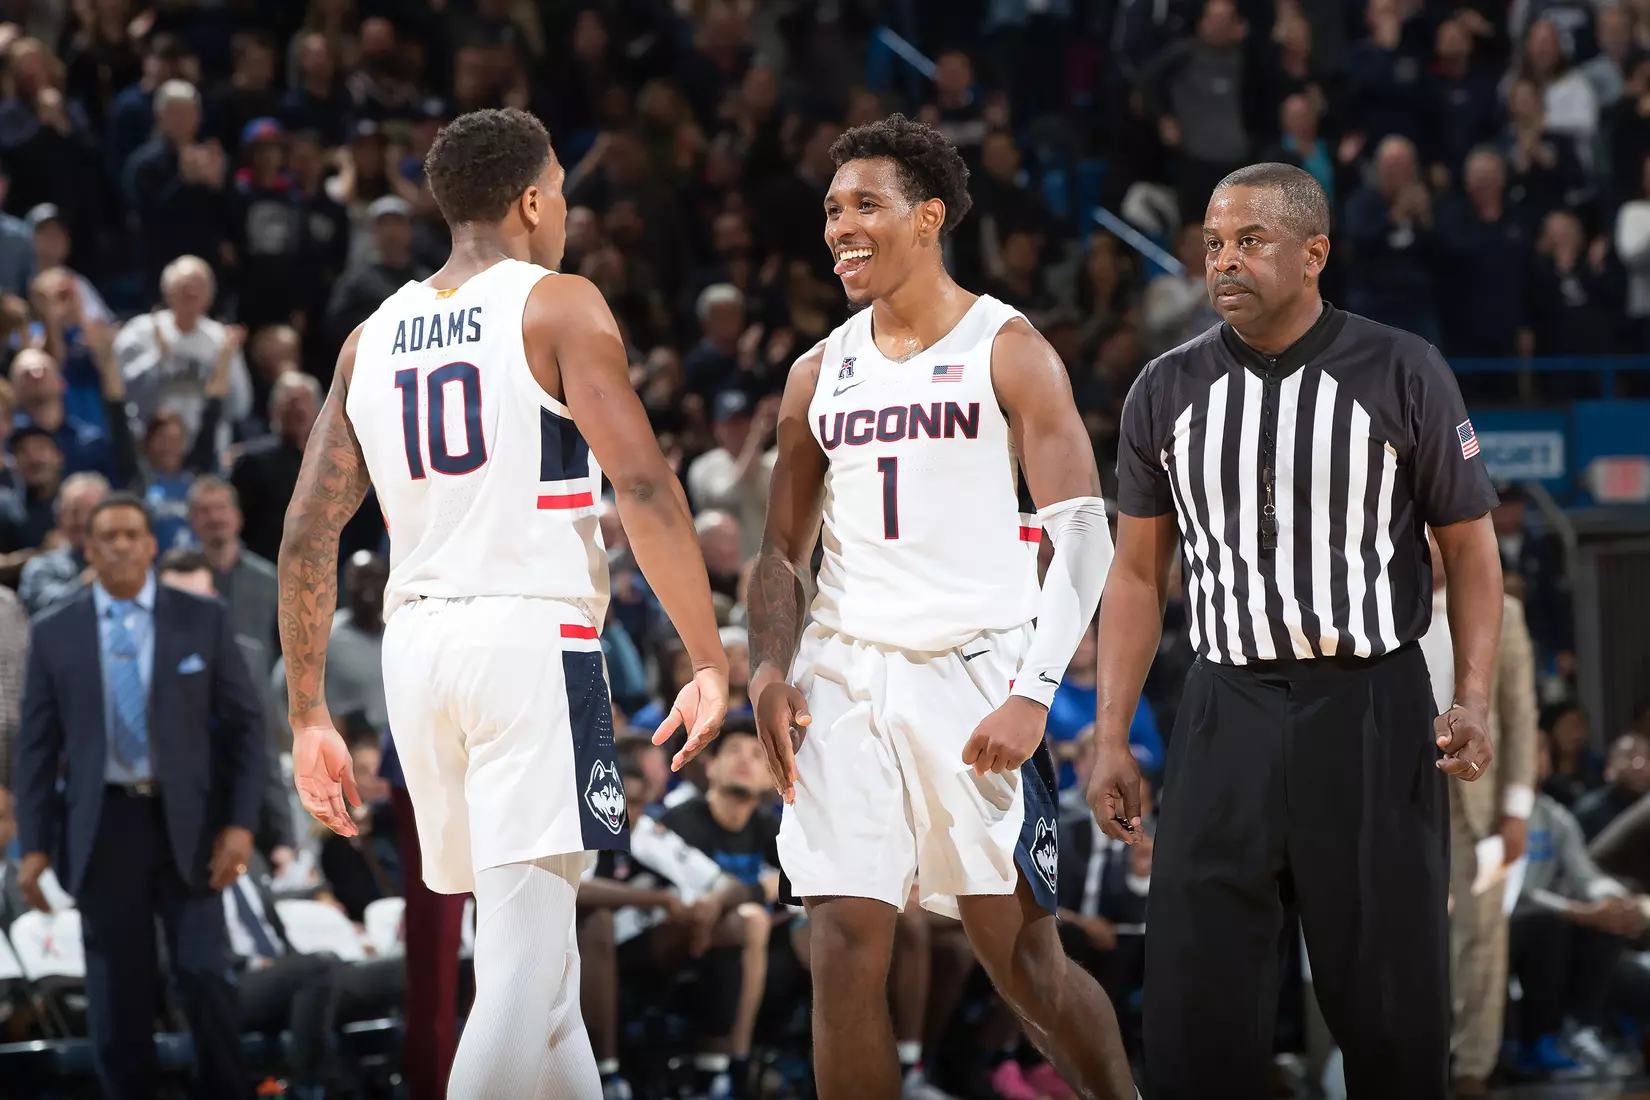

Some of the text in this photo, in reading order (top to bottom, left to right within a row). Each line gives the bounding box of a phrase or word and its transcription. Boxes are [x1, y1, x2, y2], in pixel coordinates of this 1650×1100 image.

[392, 306, 482, 355] ADAMS
[394, 361, 488, 480] 10
[819, 402, 980, 450] UCONN
[877, 456, 899, 540] 1
